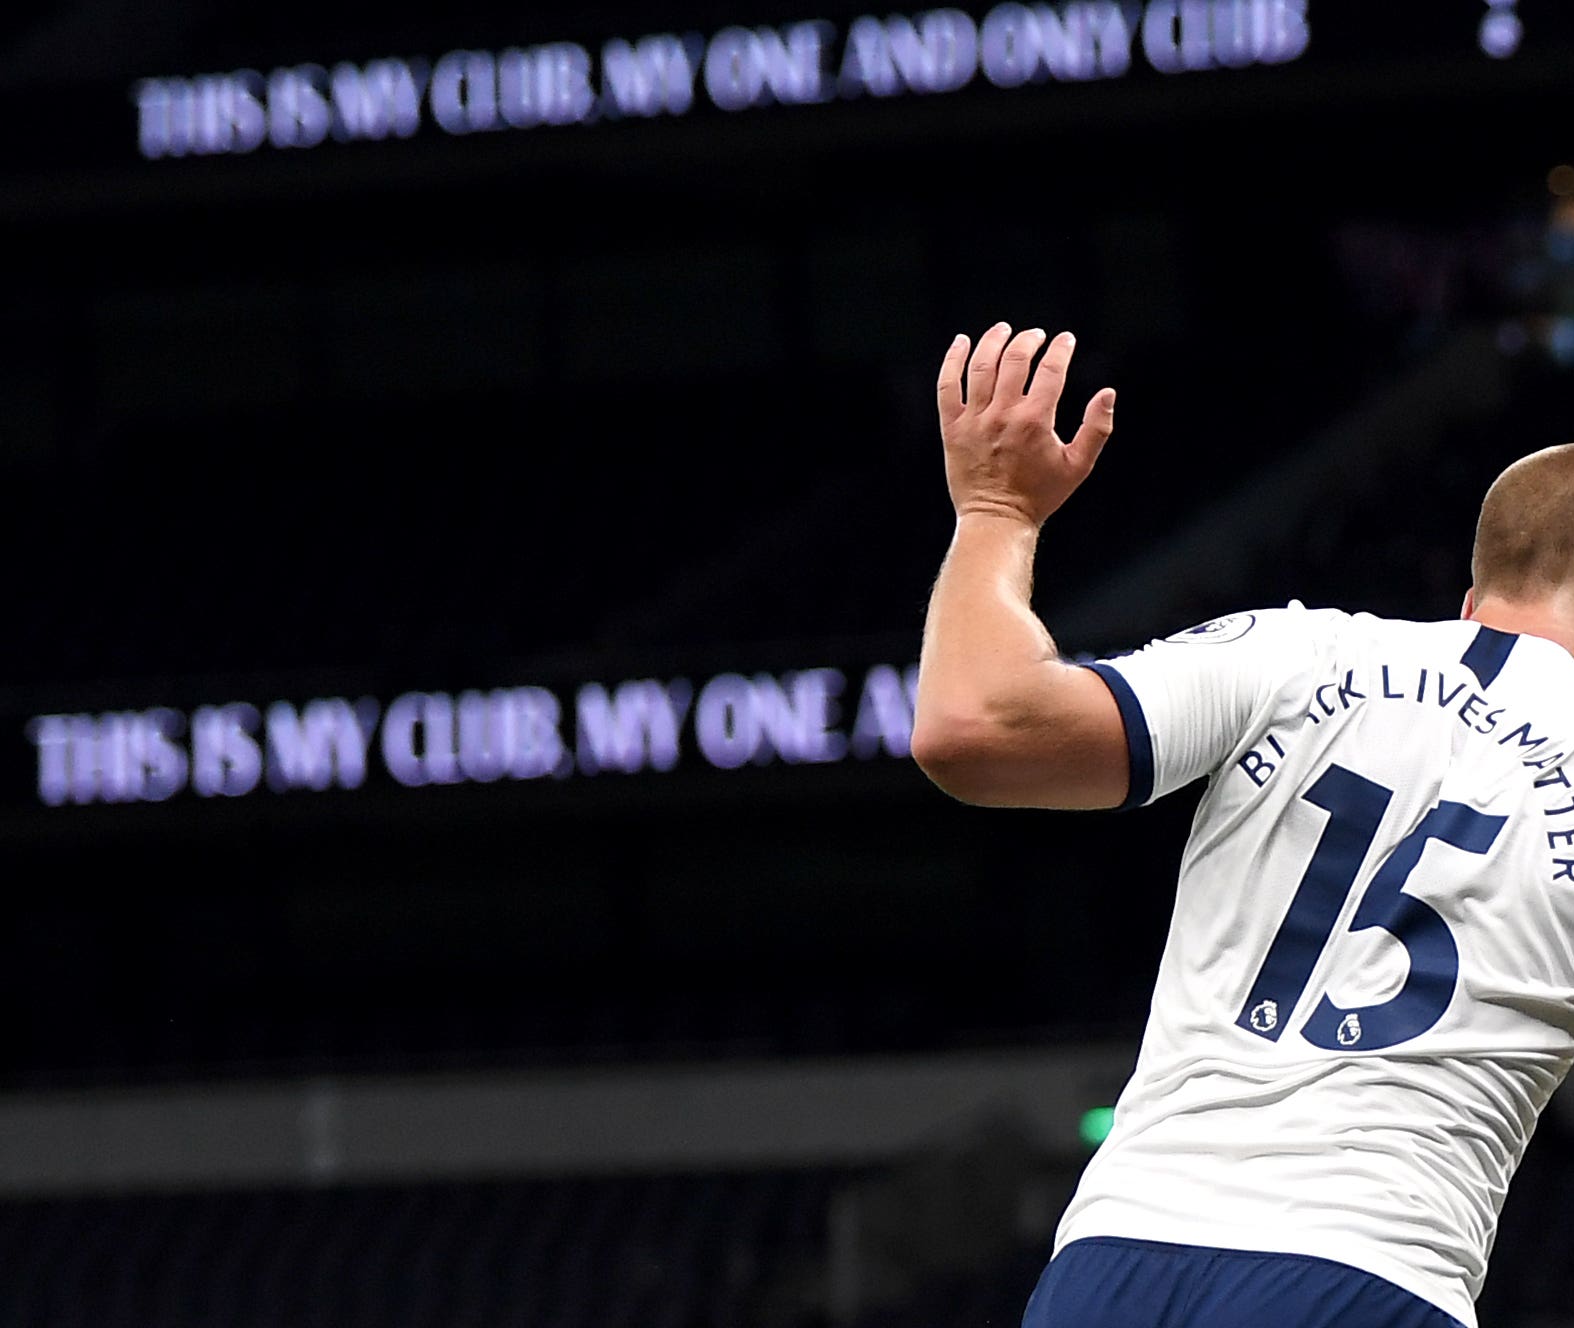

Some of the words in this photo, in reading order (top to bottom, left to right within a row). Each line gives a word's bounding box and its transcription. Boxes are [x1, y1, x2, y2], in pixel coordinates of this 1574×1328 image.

[25, 706, 188, 807] THIS
[191, 701, 262, 797] IS
[266, 696, 381, 792] MY
[576, 677, 694, 777] MY
[696, 667, 848, 769] ONE
[1381, 664, 1506, 734] LIVES
[1235, 764, 1509, 1051] 15
